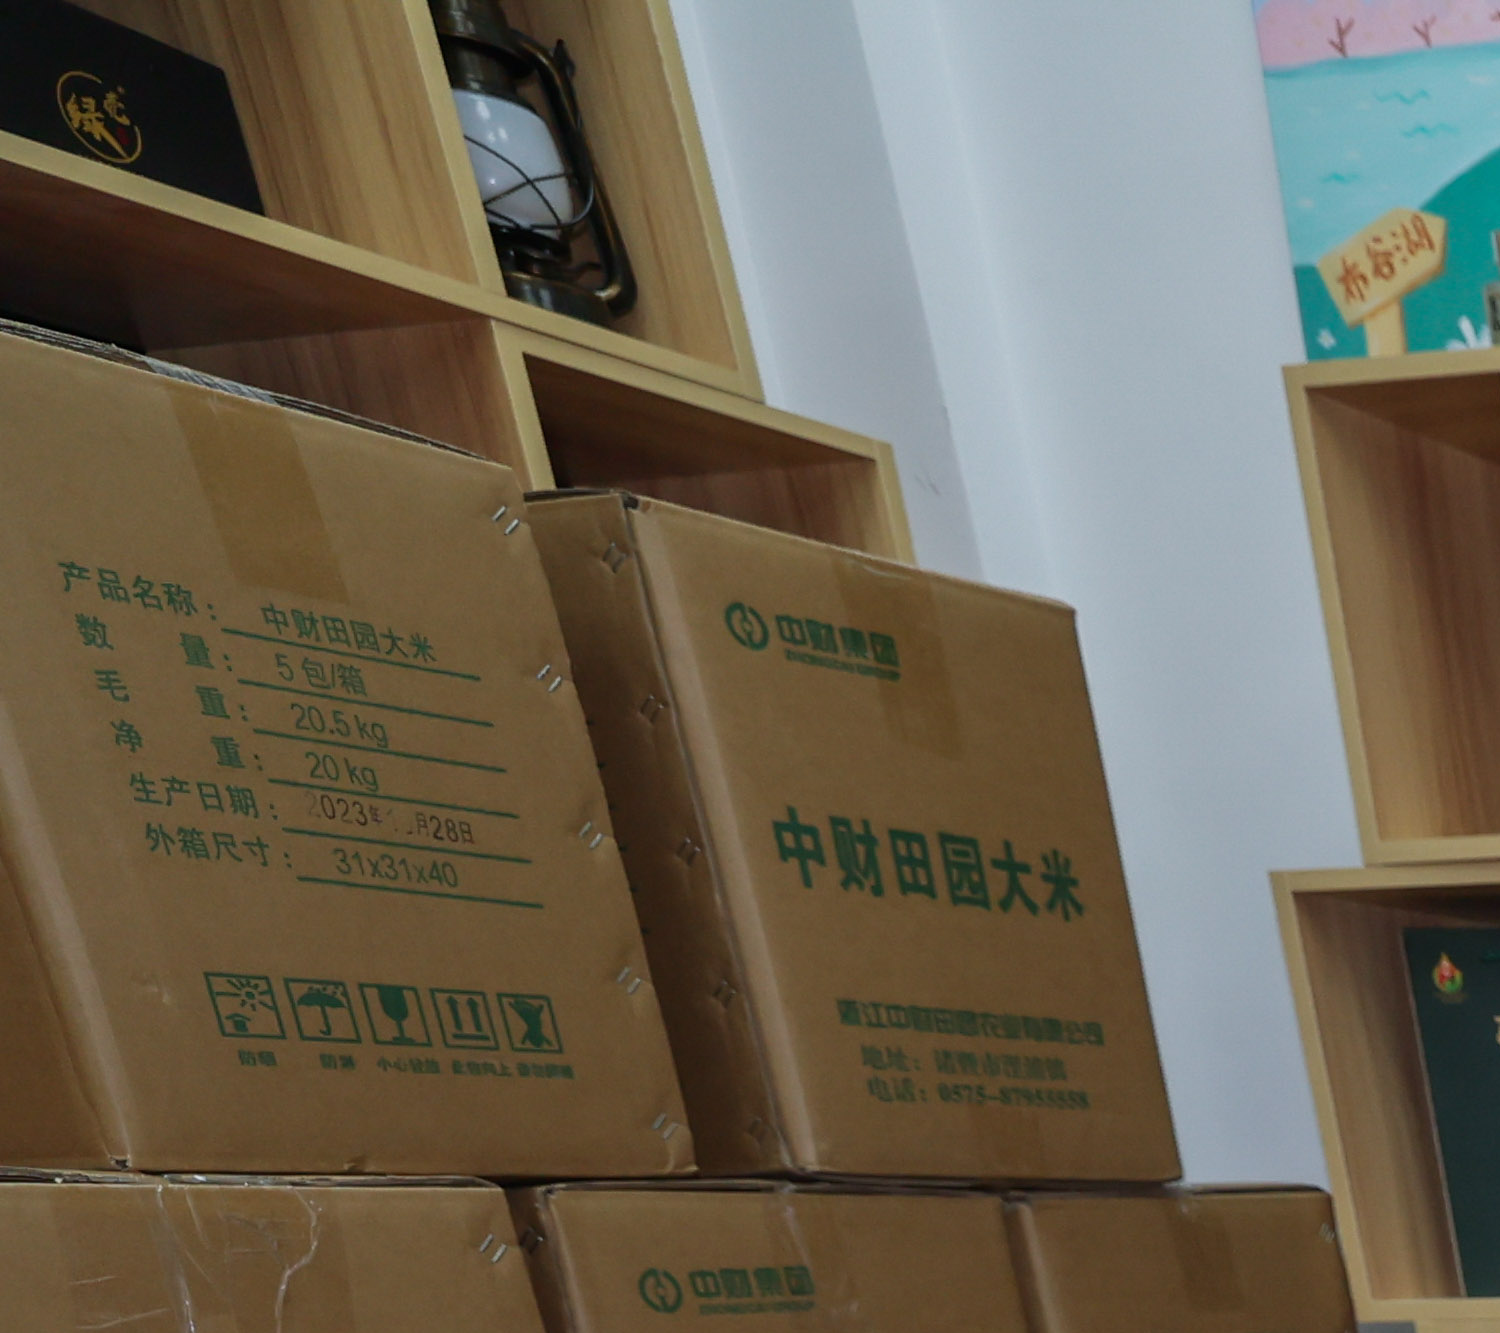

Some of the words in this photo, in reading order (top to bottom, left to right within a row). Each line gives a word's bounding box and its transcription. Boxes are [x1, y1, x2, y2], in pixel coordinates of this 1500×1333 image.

[262, 604, 436, 663] 中财田园大米
[772, 804, 1085, 922] 中财田园大米
